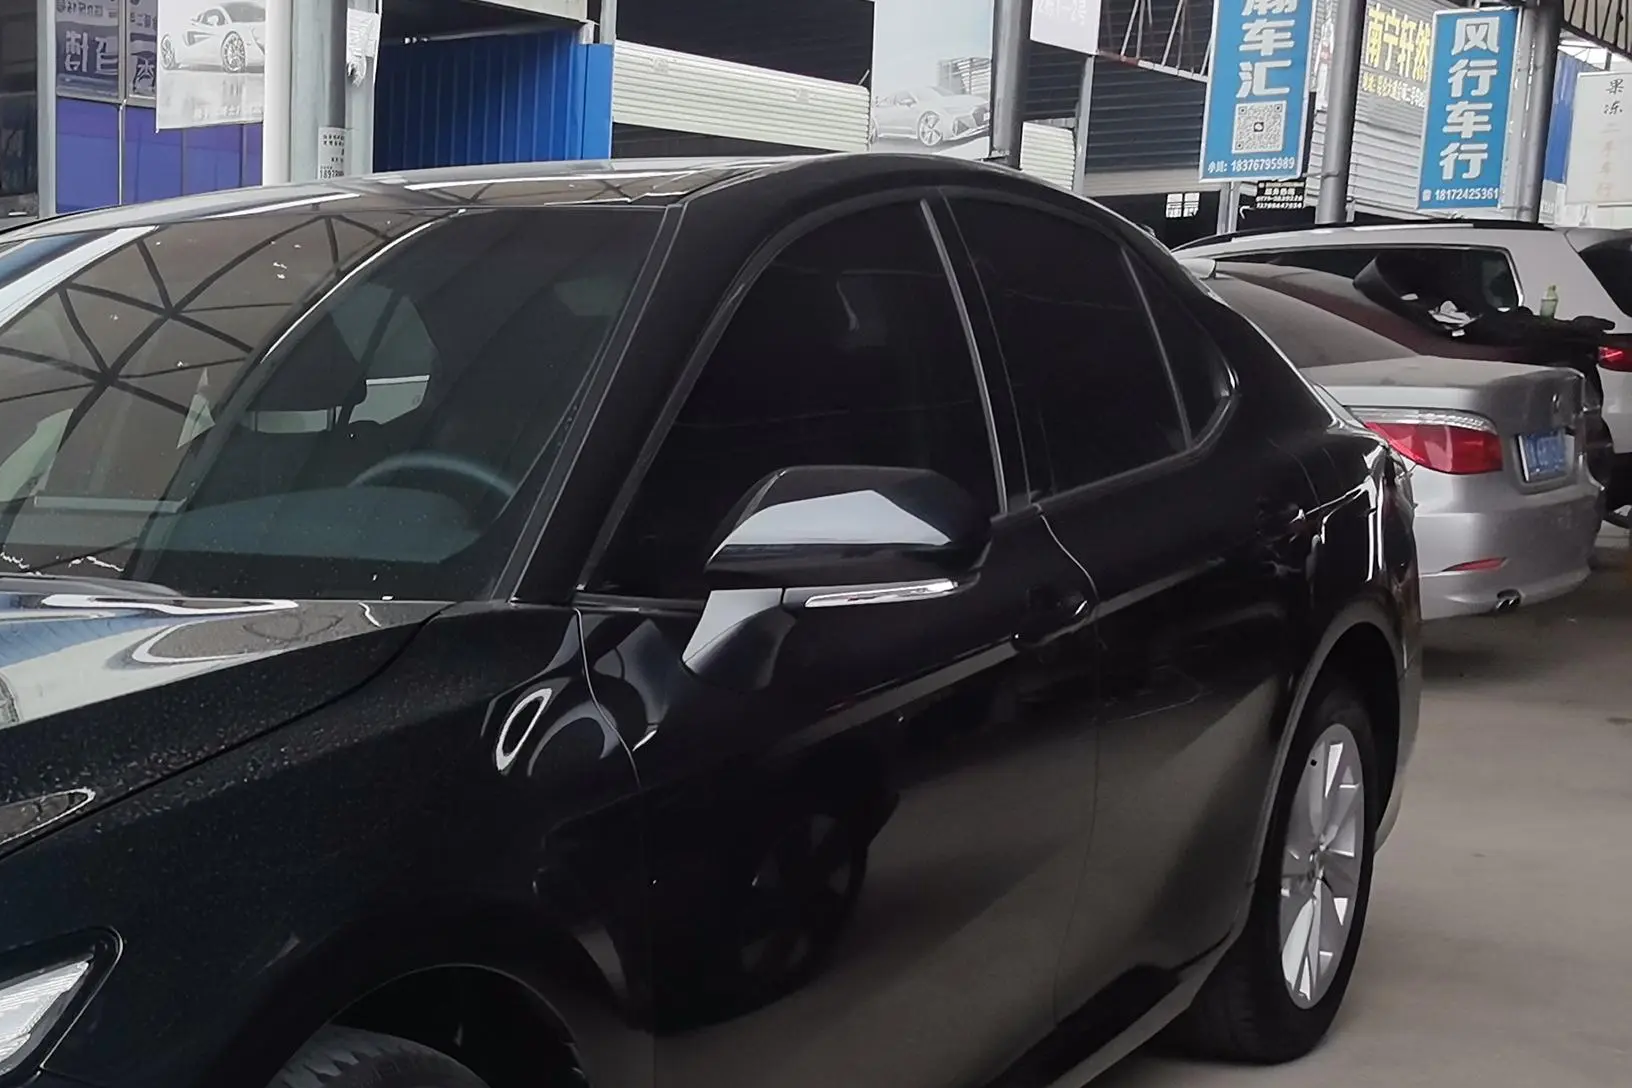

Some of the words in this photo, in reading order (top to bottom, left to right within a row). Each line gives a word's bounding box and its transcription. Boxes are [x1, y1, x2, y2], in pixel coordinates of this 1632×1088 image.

[1439, 16, 1500, 180] 风行车行
[1231, 156, 1296, 172] 18376795989
[1435, 187, 1499, 201] 18172425361
